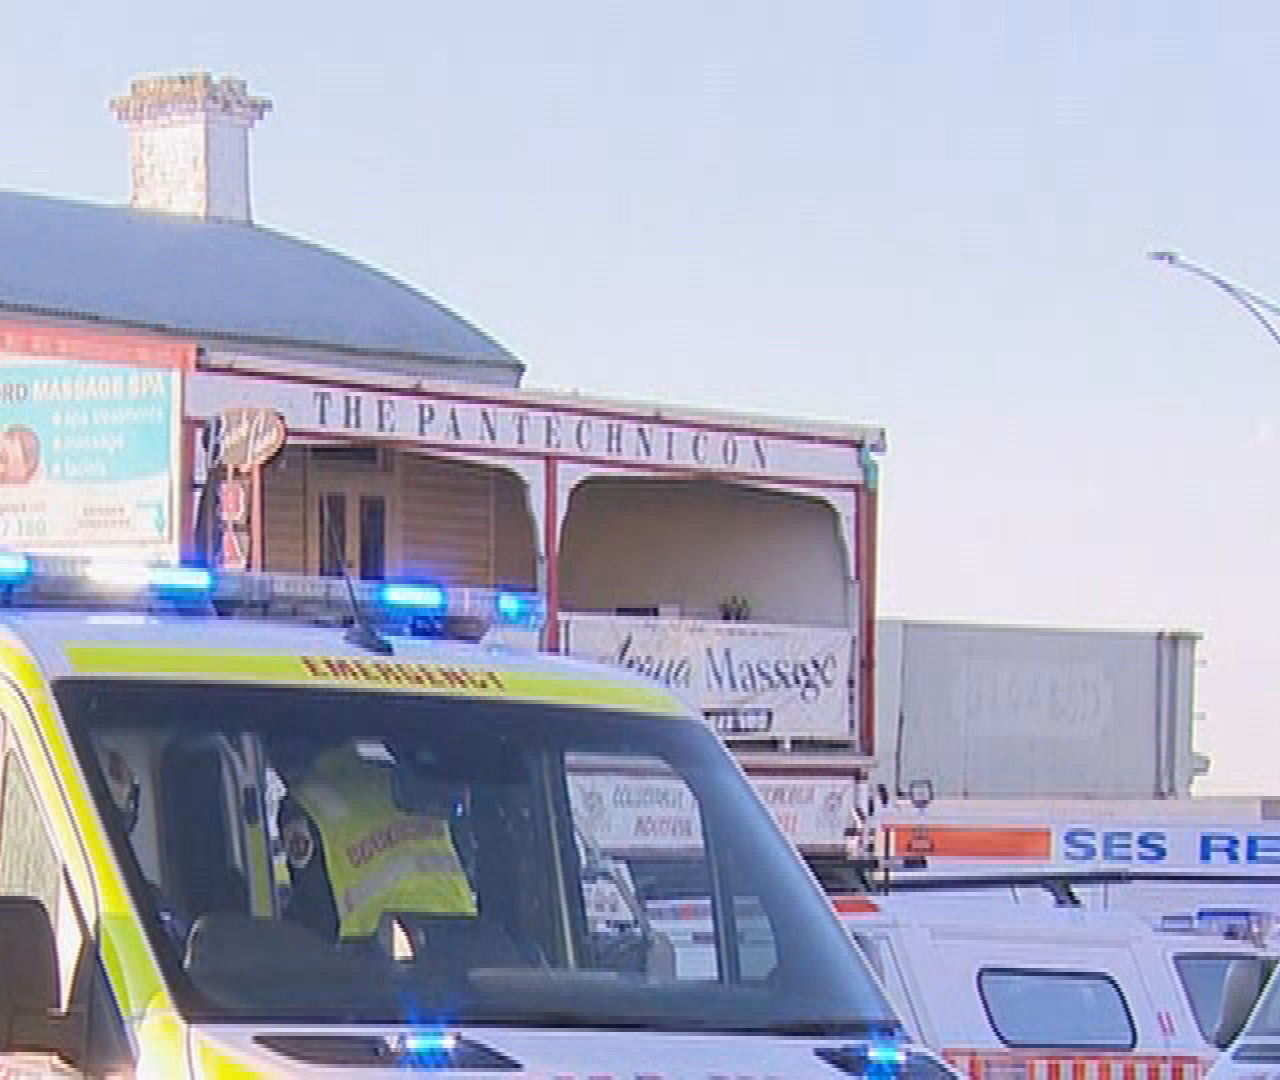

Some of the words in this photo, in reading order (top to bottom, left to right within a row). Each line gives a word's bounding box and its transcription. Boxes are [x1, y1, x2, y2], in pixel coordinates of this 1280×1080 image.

[313, 391, 396, 434] THE
[418, 400, 766, 470] PANTECHNICON
[301, 656, 505, 692] EMERGENCY
[707, 646, 836, 701] Massage
[1063, 829, 1167, 862] SES
